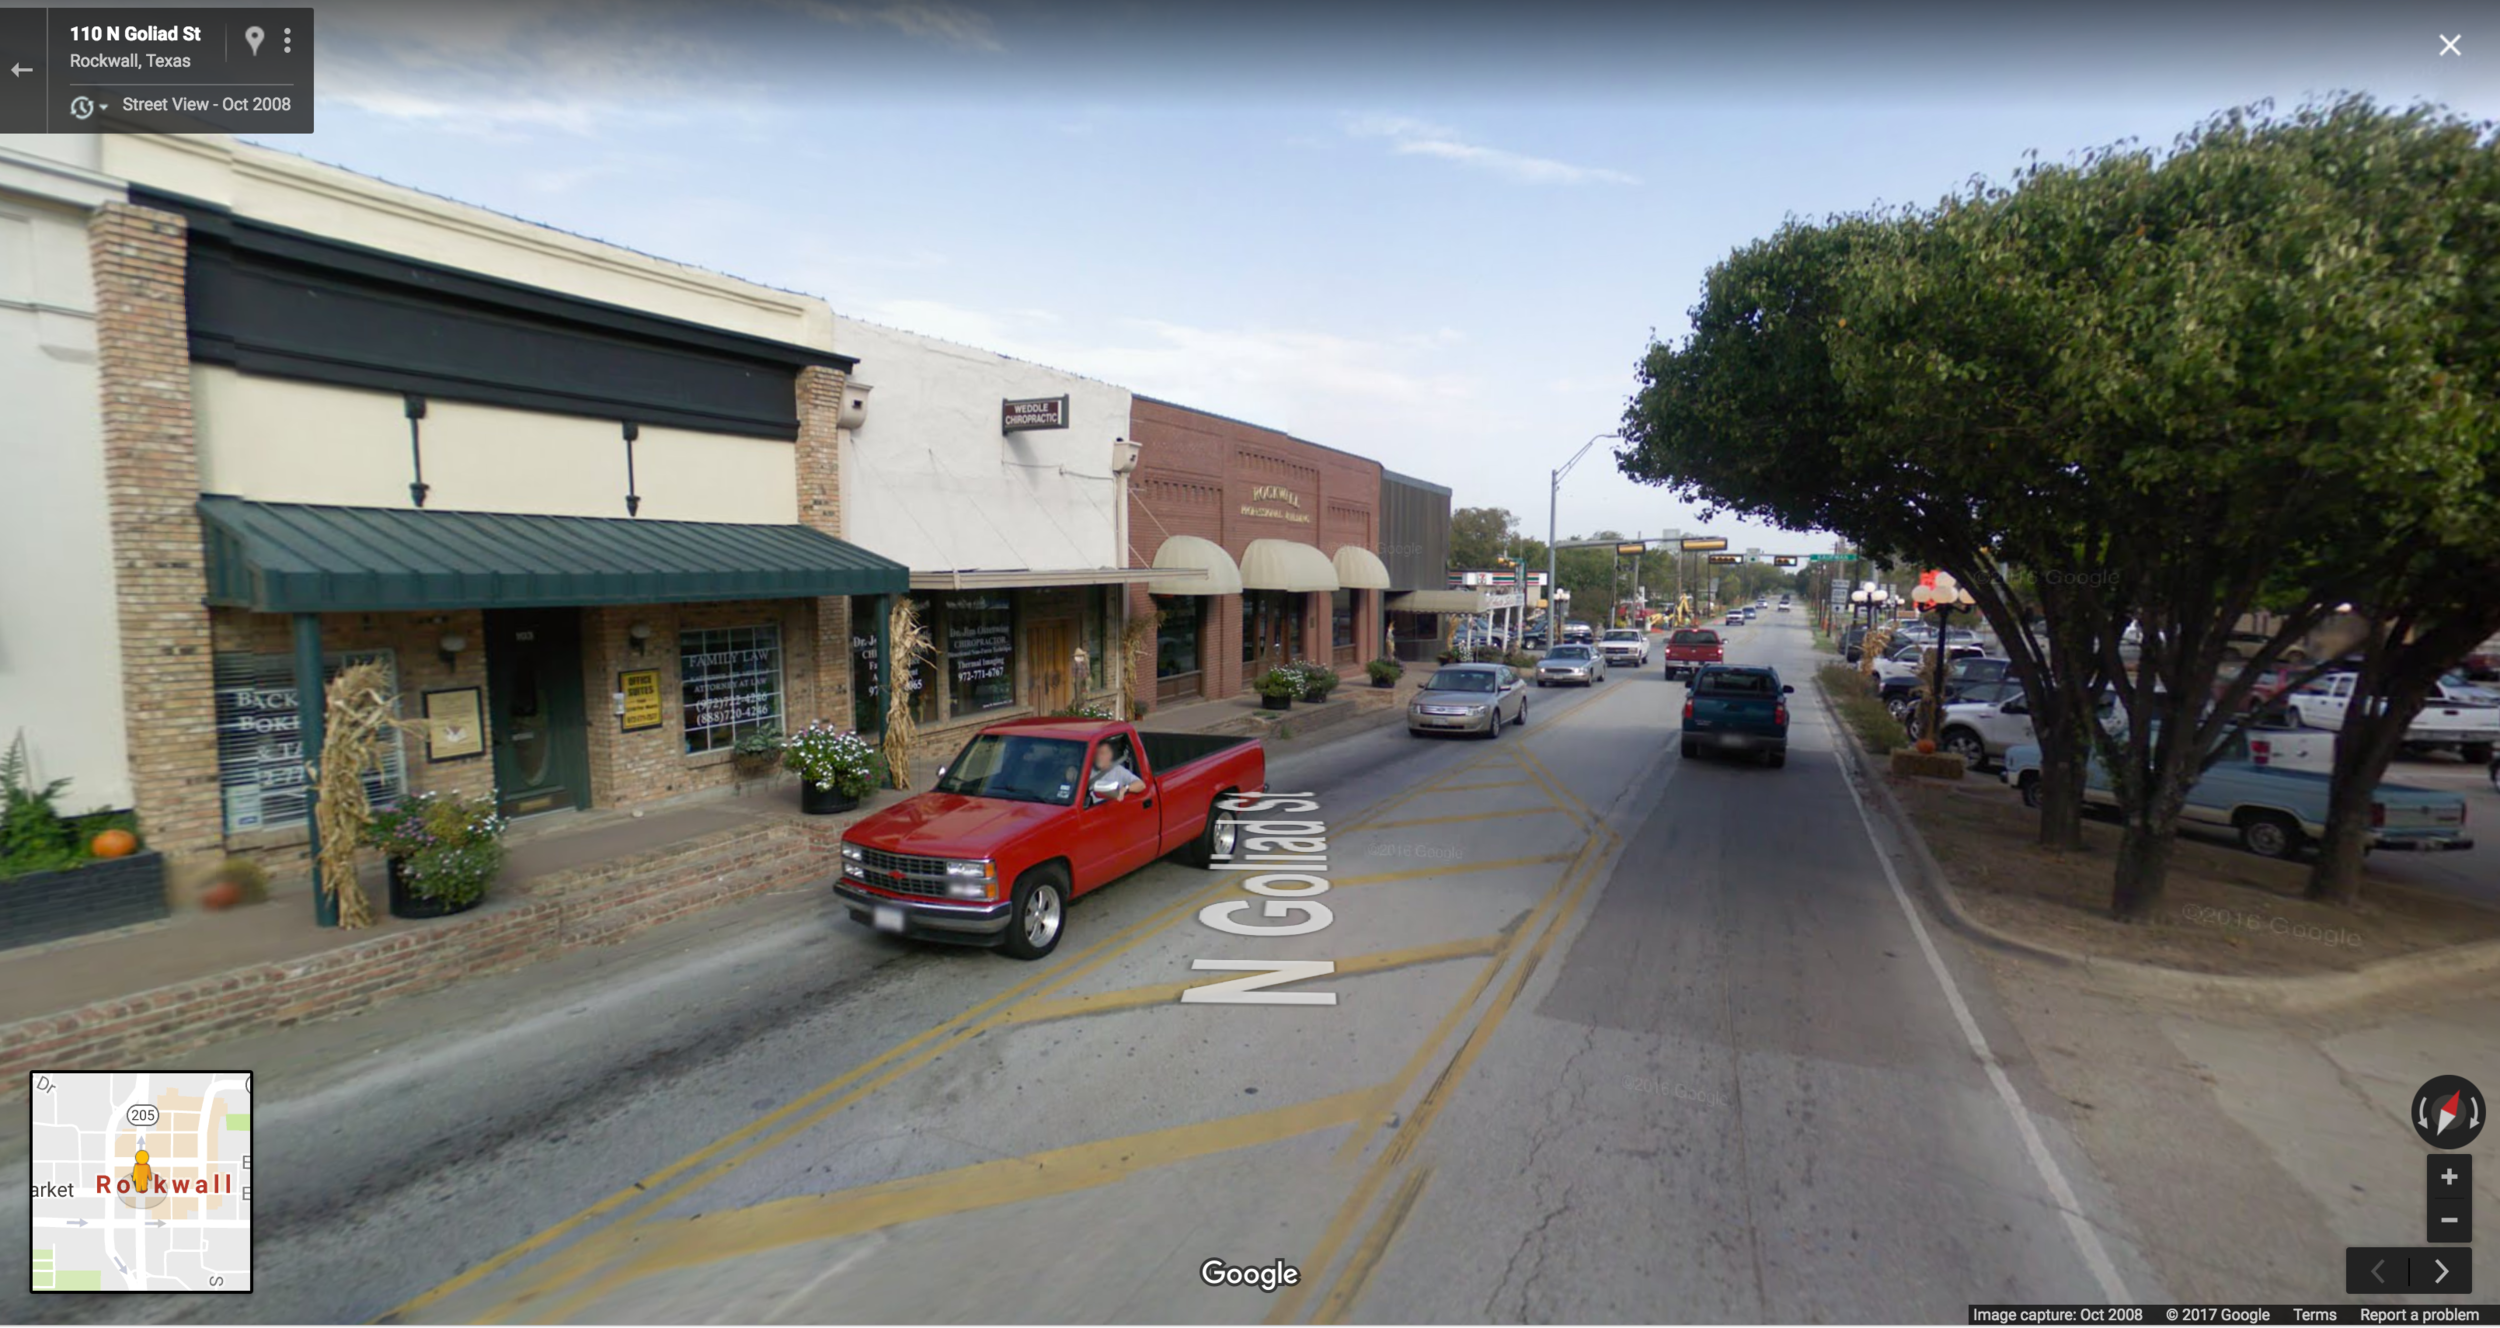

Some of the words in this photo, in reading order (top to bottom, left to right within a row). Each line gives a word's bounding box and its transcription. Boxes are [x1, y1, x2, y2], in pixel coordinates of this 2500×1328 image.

[1014, 403, 1049, 413] WEDDLE
[1005, 413, 1057, 425] CHIROPRACTIC
[853, 636, 867, 648] Dr.
[953, 636, 1007, 649] CHIROPRACTOR
[689, 650, 738, 668] FAMILY
[742, 648, 769, 663] LAW
[957, 666, 1004, 682] 972-771-6767
[693, 681, 739, 693] ATTORNEY
